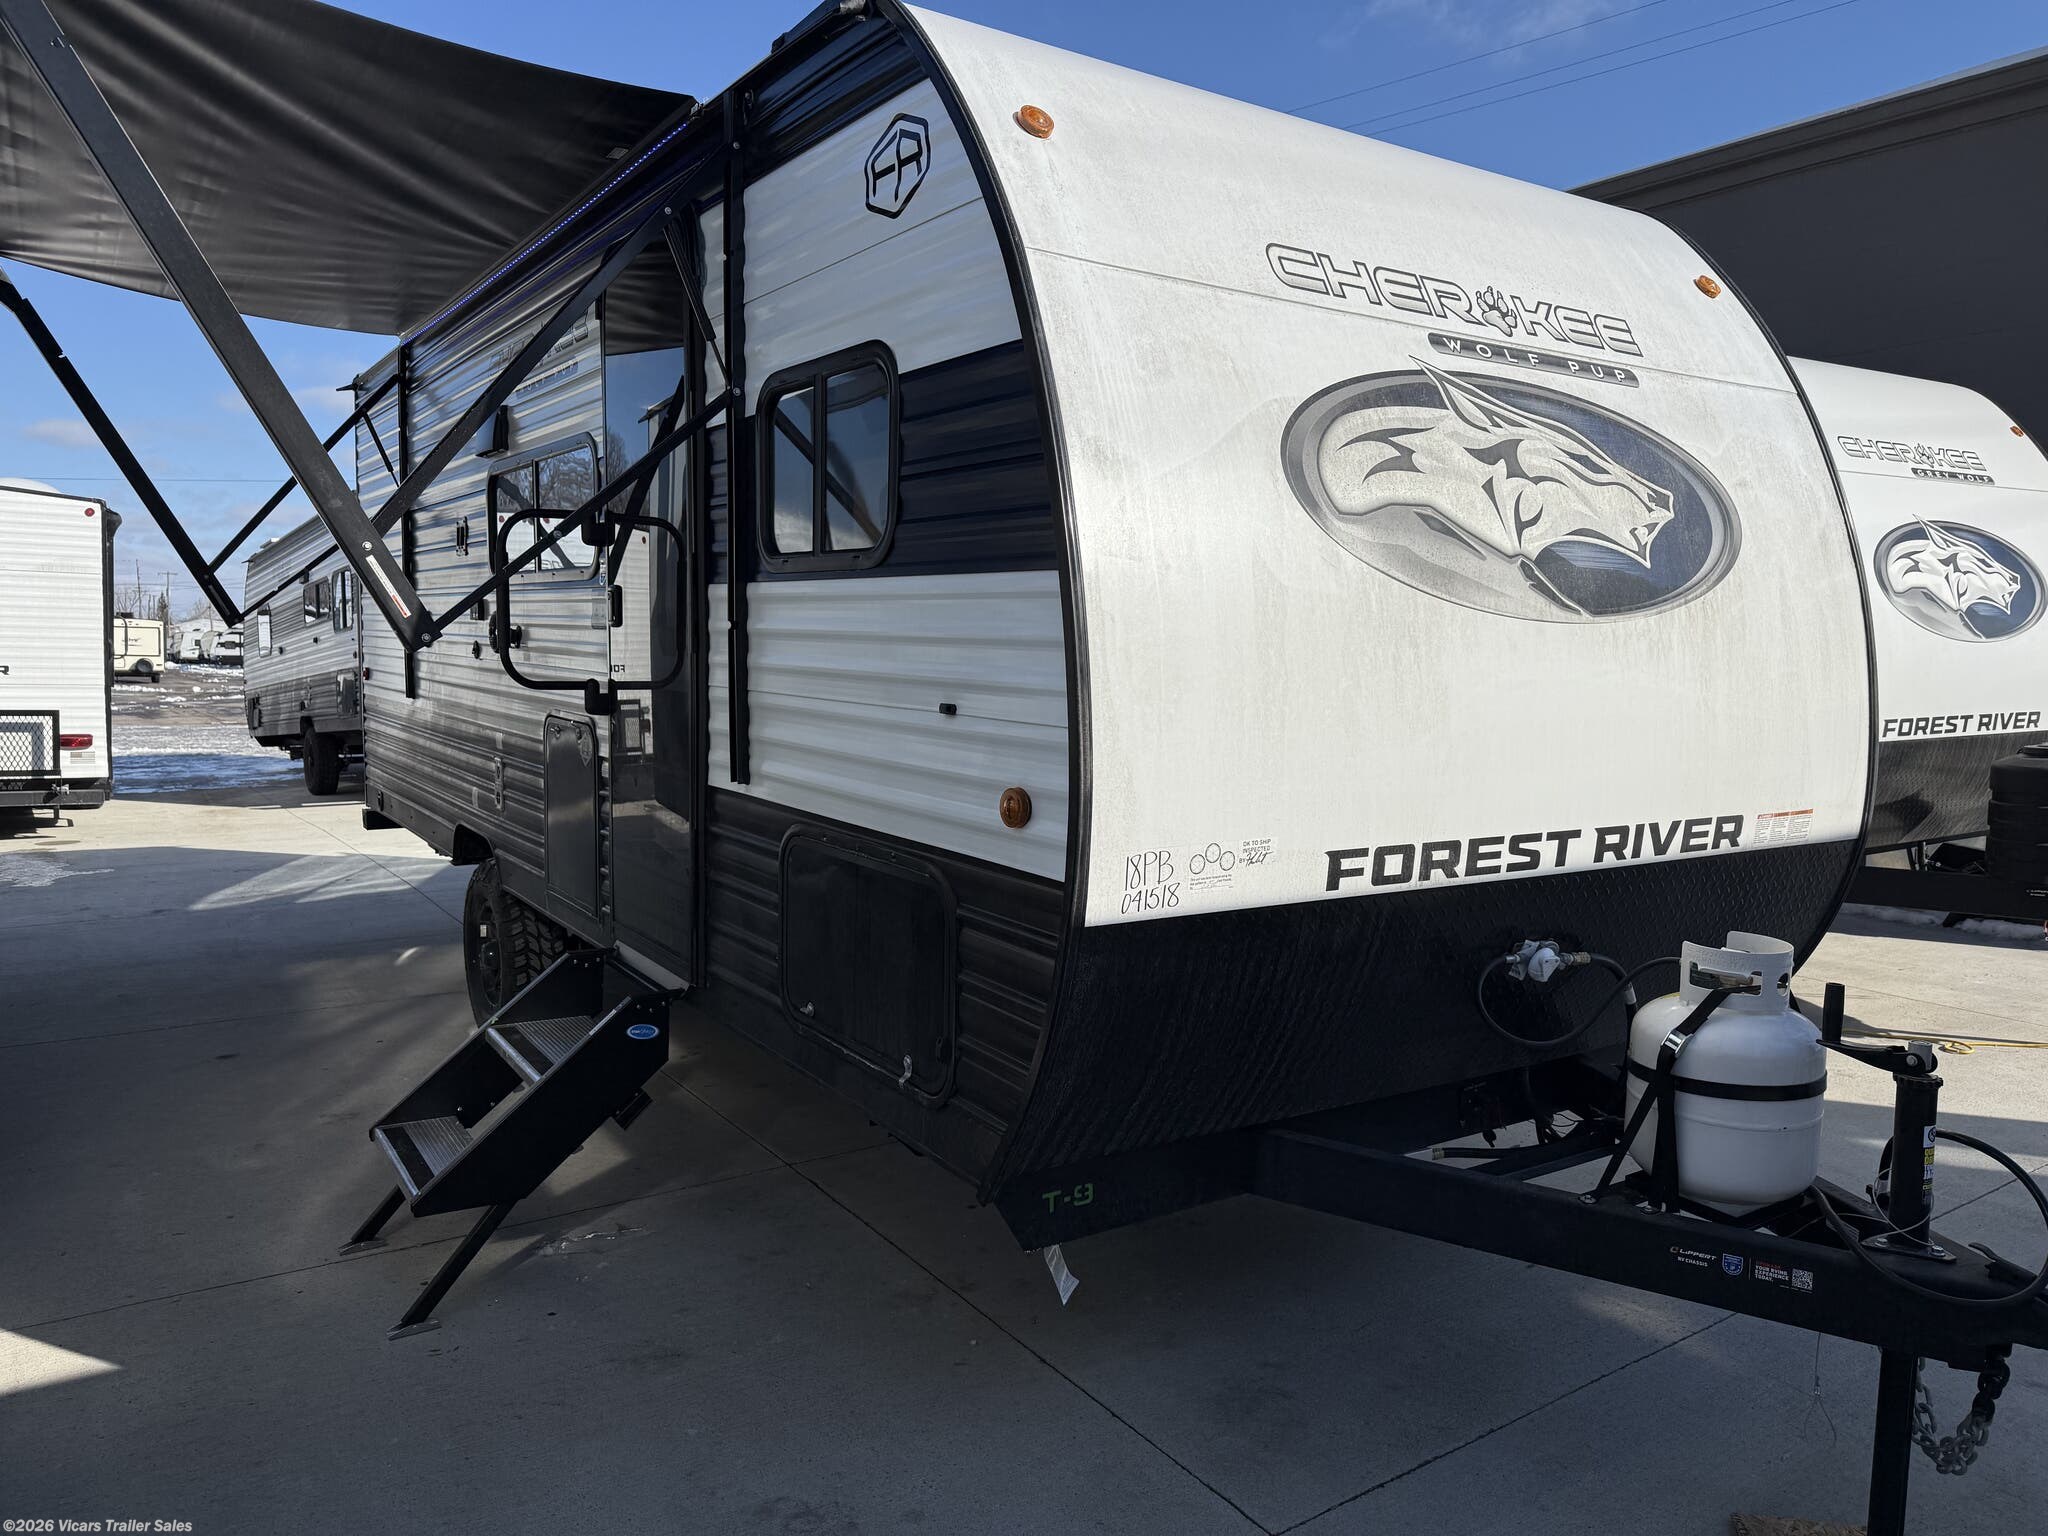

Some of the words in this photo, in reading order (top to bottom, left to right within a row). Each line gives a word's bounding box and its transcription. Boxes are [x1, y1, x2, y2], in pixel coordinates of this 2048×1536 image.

[1442, 337, 1541, 367] WOLF
[1567, 361, 1627, 383] PUP
[1916, 468, 1949, 481] GREY
[1957, 474, 1990, 485] WOLF
[1882, 714, 1974, 738] FOREST
[1977, 711, 2041, 732] RIVER
[1324, 828, 1582, 892] FOREST
[1593, 814, 1745, 864] RIVER
[1125, 850, 1174, 891] 18PB
[1121, 882, 1180, 915] 041518
[1685, 1258, 1708, 1267] CHASSIS
[1755, 1269, 1789, 1281] EXPERIENCE
